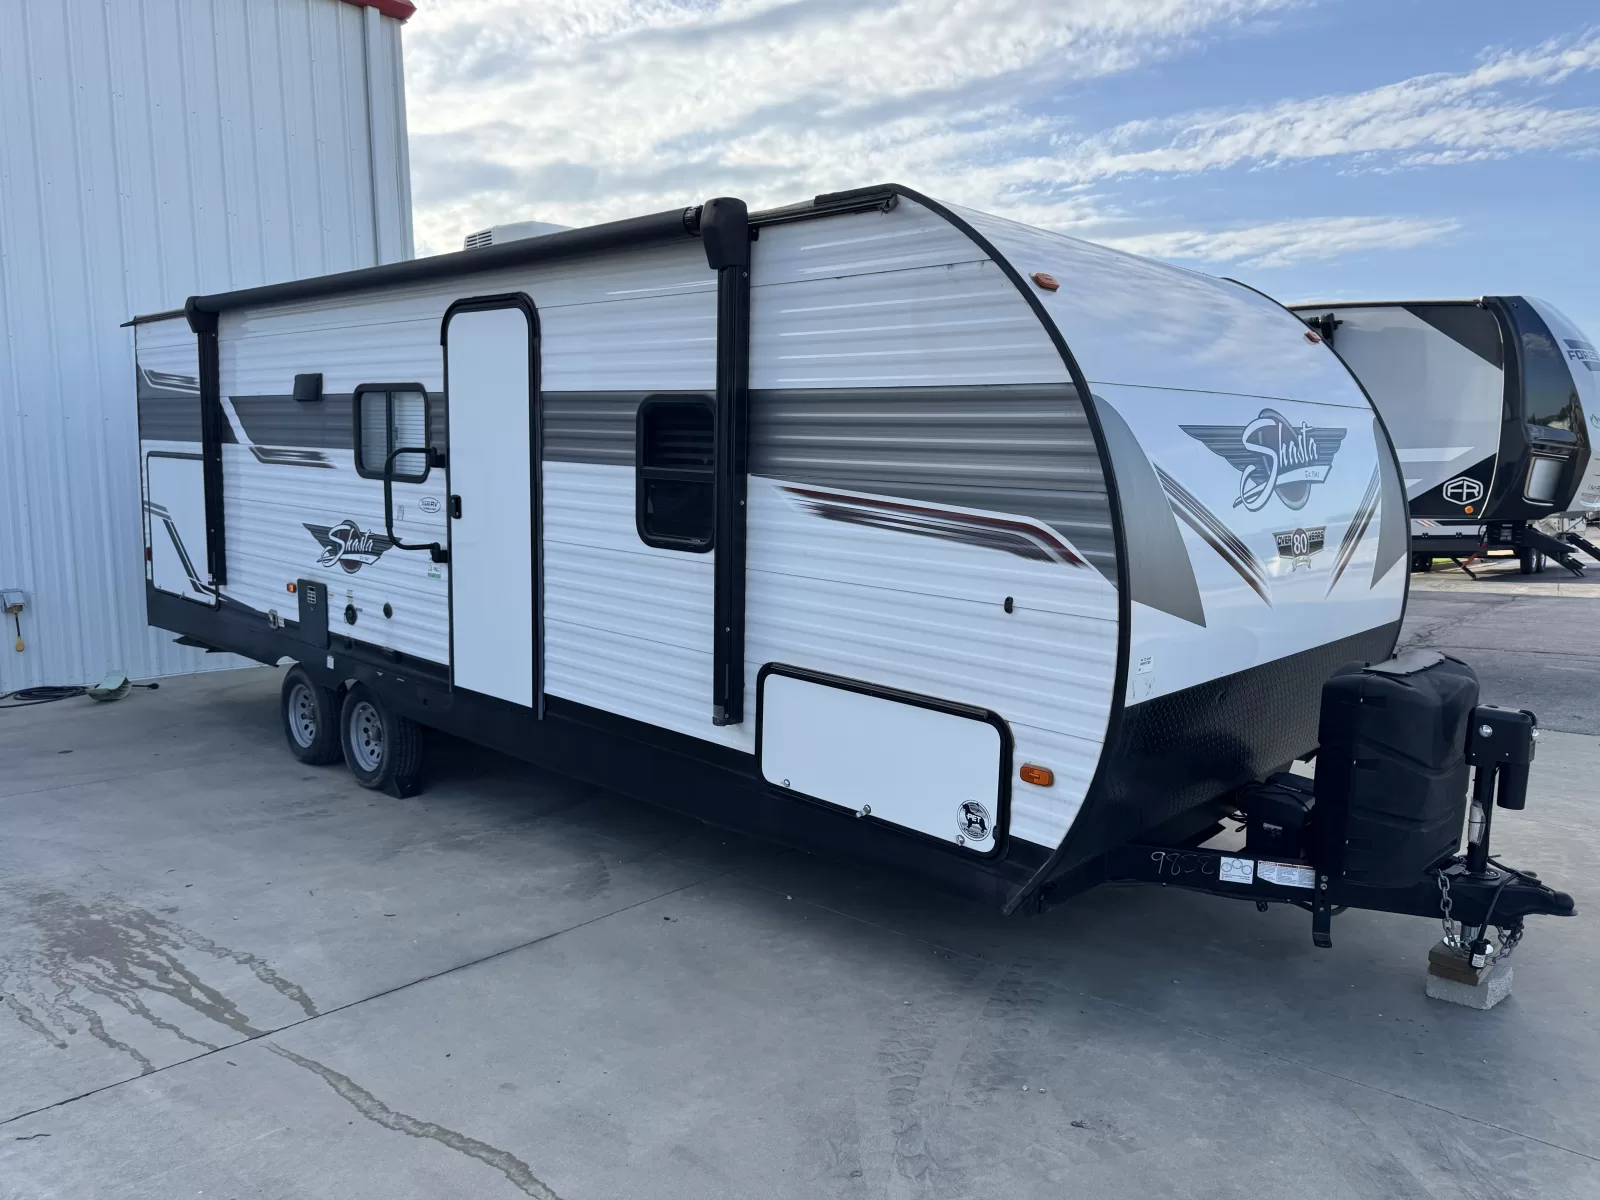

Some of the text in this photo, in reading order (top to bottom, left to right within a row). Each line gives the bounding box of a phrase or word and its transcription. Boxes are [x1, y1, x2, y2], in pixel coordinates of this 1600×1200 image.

[1233, 418, 1318, 512] Shasta
[318, 524, 374, 567] Shasta
[1278, 530, 1324, 555] OVER 80 YEARS
[967, 813, 982, 823] PET
